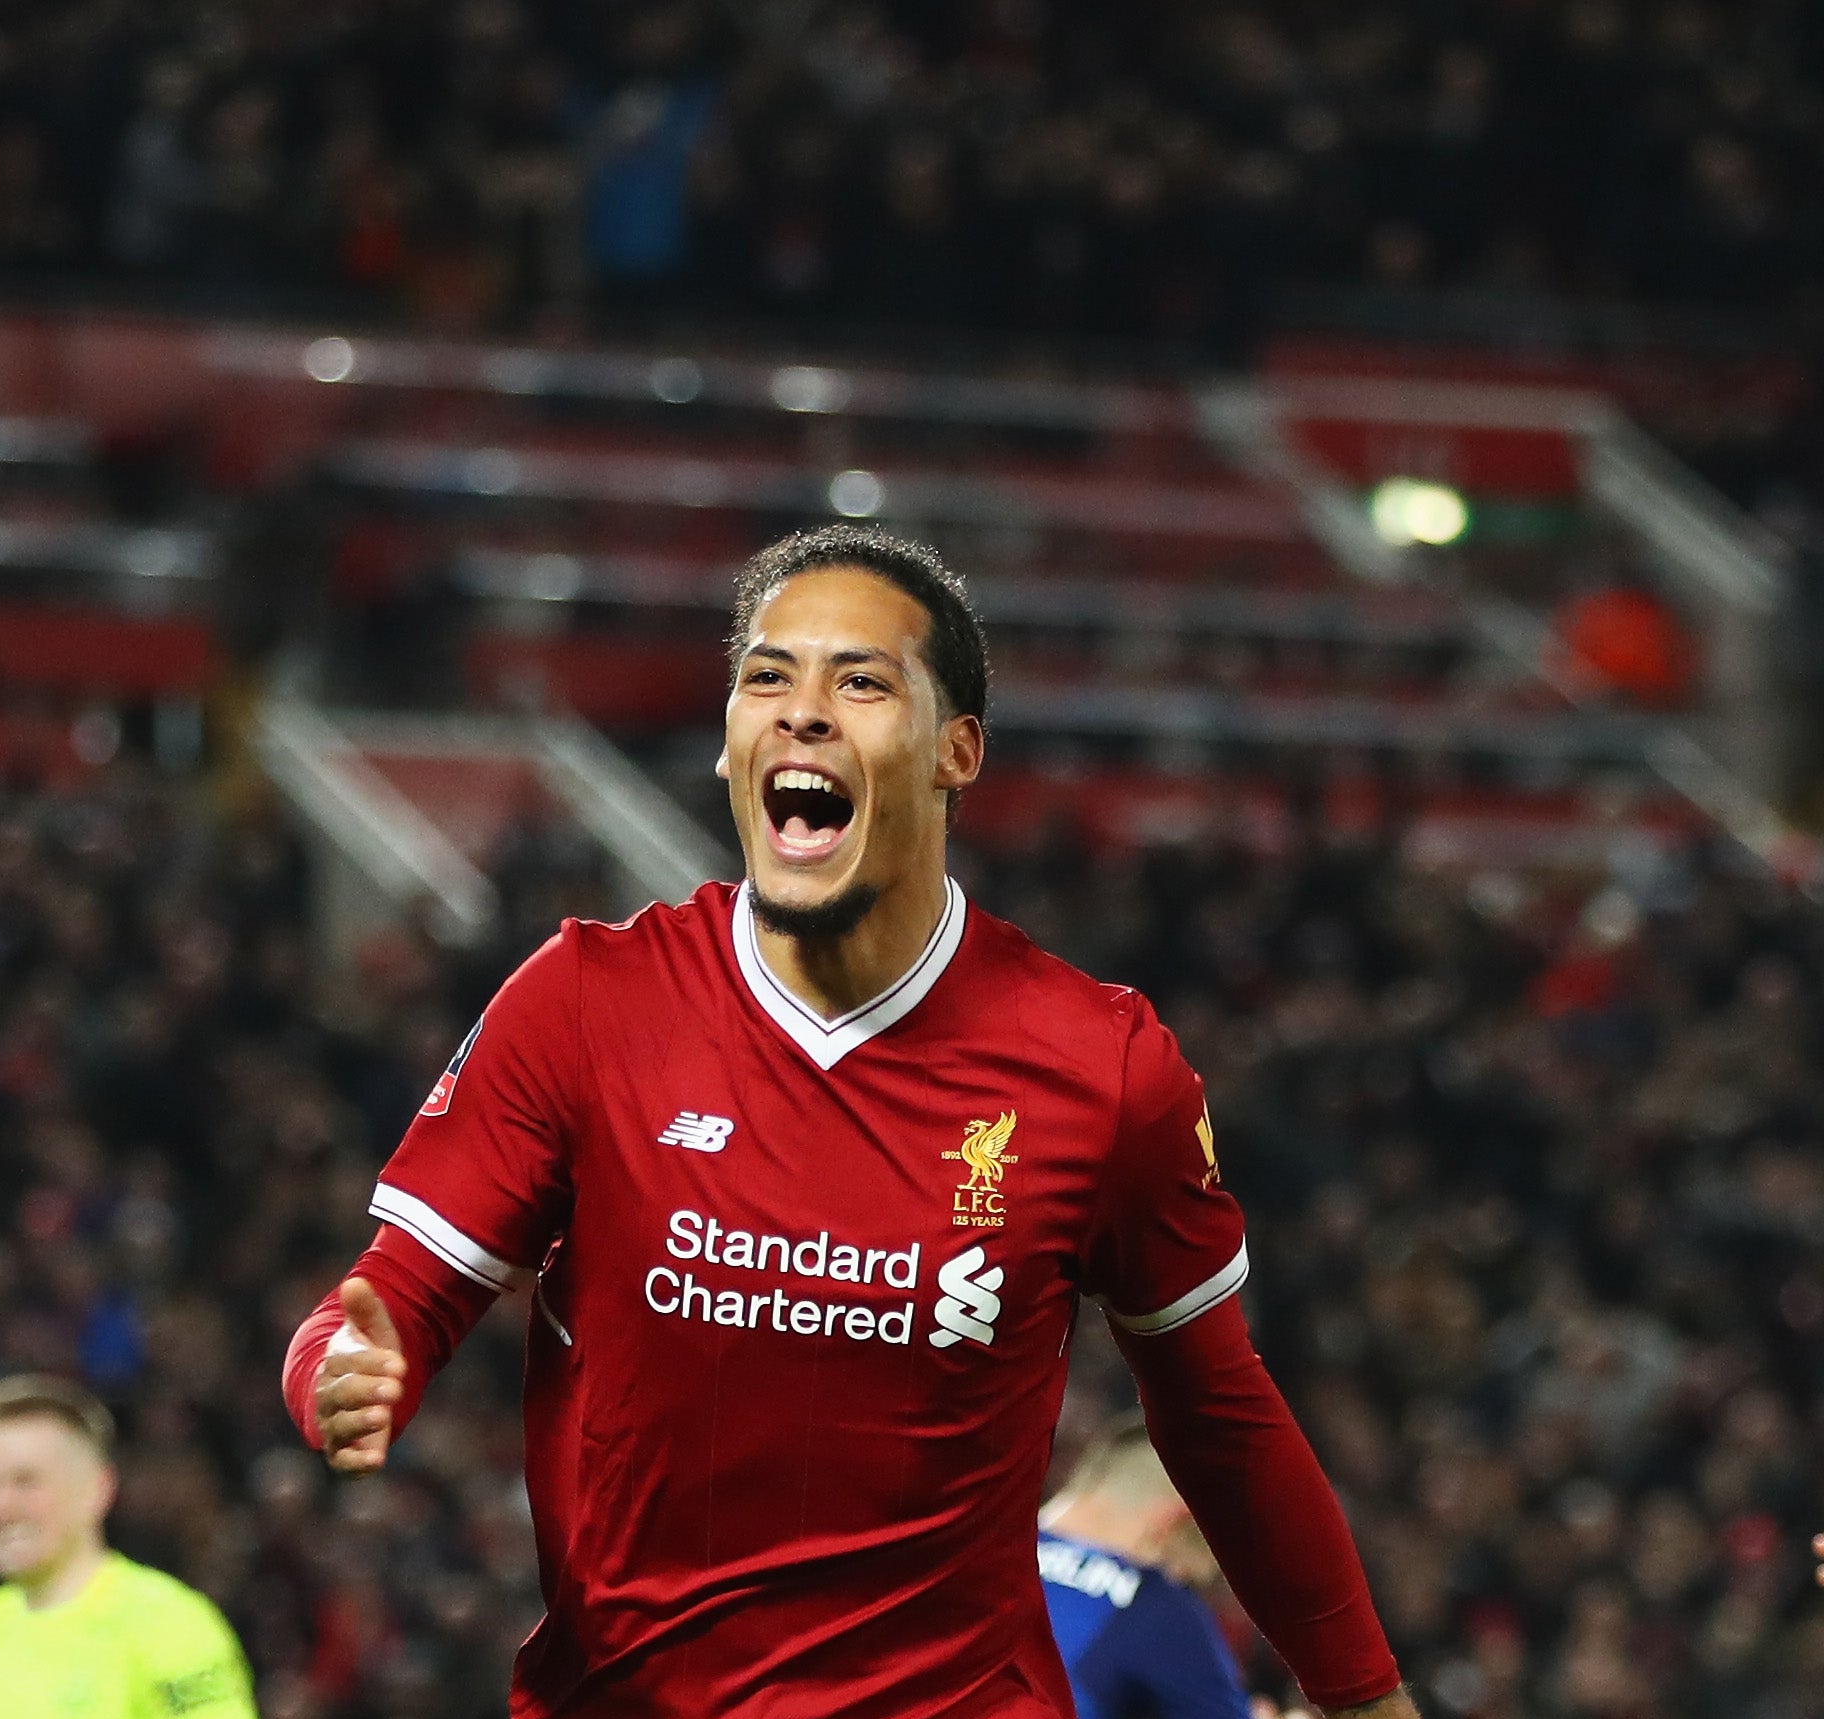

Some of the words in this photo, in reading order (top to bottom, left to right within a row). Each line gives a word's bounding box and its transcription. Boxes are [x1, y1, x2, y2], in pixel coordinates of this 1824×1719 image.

[665, 1209, 921, 1290] Standard
[952, 1215, 969, 1226] 125
[970, 1216, 1005, 1227] YEARS
[644, 1266, 915, 1345] Chartered
